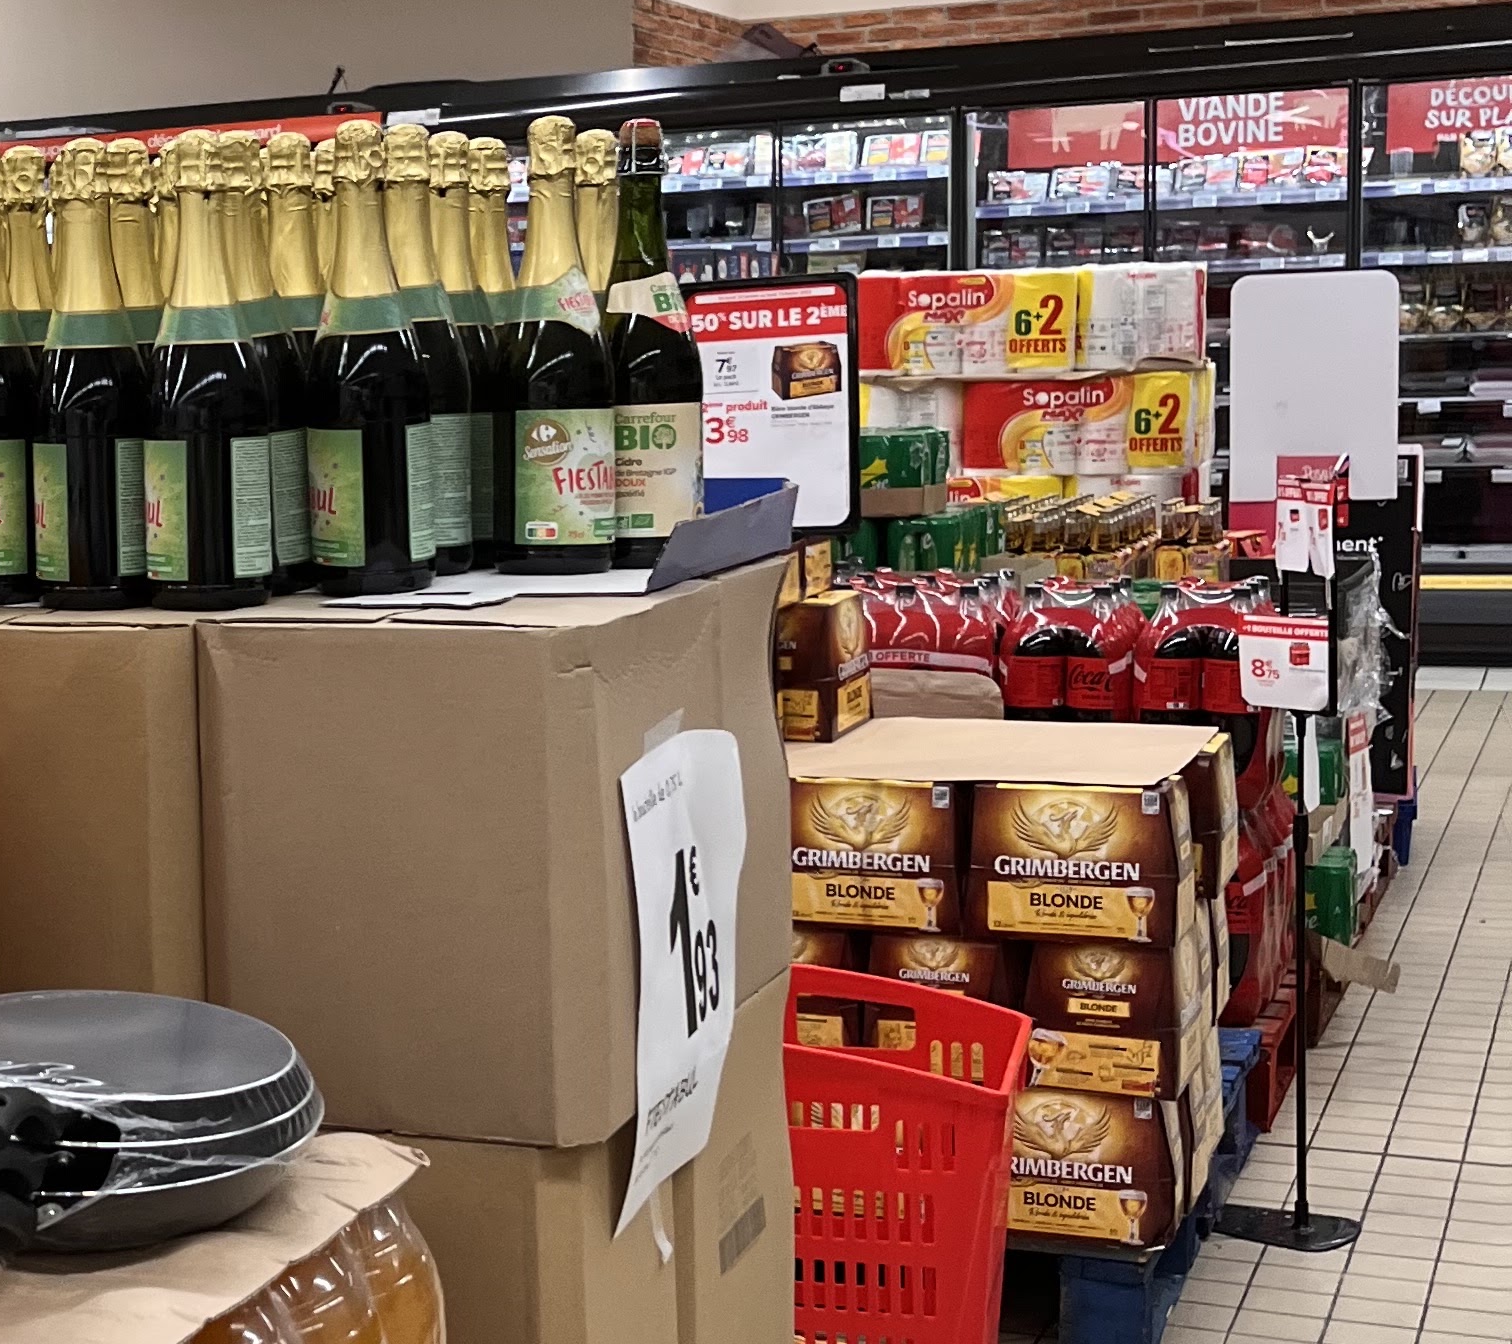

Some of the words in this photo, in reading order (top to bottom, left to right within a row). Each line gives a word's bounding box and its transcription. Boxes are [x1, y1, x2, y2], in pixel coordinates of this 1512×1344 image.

[1431, 79, 1512, 107] DÉCOU
[1178, 92, 1284, 121] VIANDE
[1424, 108, 1473, 129] SUR
[1178, 120, 1284, 147] BOVINE
[908, 289, 985, 310] Sopalin
[728, 309, 773, 331] SUR
[777, 307, 802, 327] LE
[1009, 338, 1066, 354] OFFERTS
[726, 400, 768, 414] produit
[1023, 387, 1104, 408] Sopalin
[615, 411, 677, 424] Carrefour
[615, 424, 677, 450] BIO
[1129, 437, 1183, 453] OFFERTS
[552, 460, 615, 495] FIESTA
[615, 478, 646, 487] DOUX
[875, 651, 930, 663] OFFERTE
[792, 847, 931, 873] GRIMBERGEN
[994, 855, 1140, 881] GRIMBERGEN
[825, 883, 896, 901] BLONDE
[1029, 892, 1104, 910] BLONDE
[899, 968, 970, 983] GRIMBERGEN
[1062, 978, 1137, 994] GRIMBERGEN
[1080, 1002, 1117, 1013] BLONDE
[1010, 1157, 1133, 1184] RIMBERGEN
[1023, 1191, 1096, 1211] BLONDE
